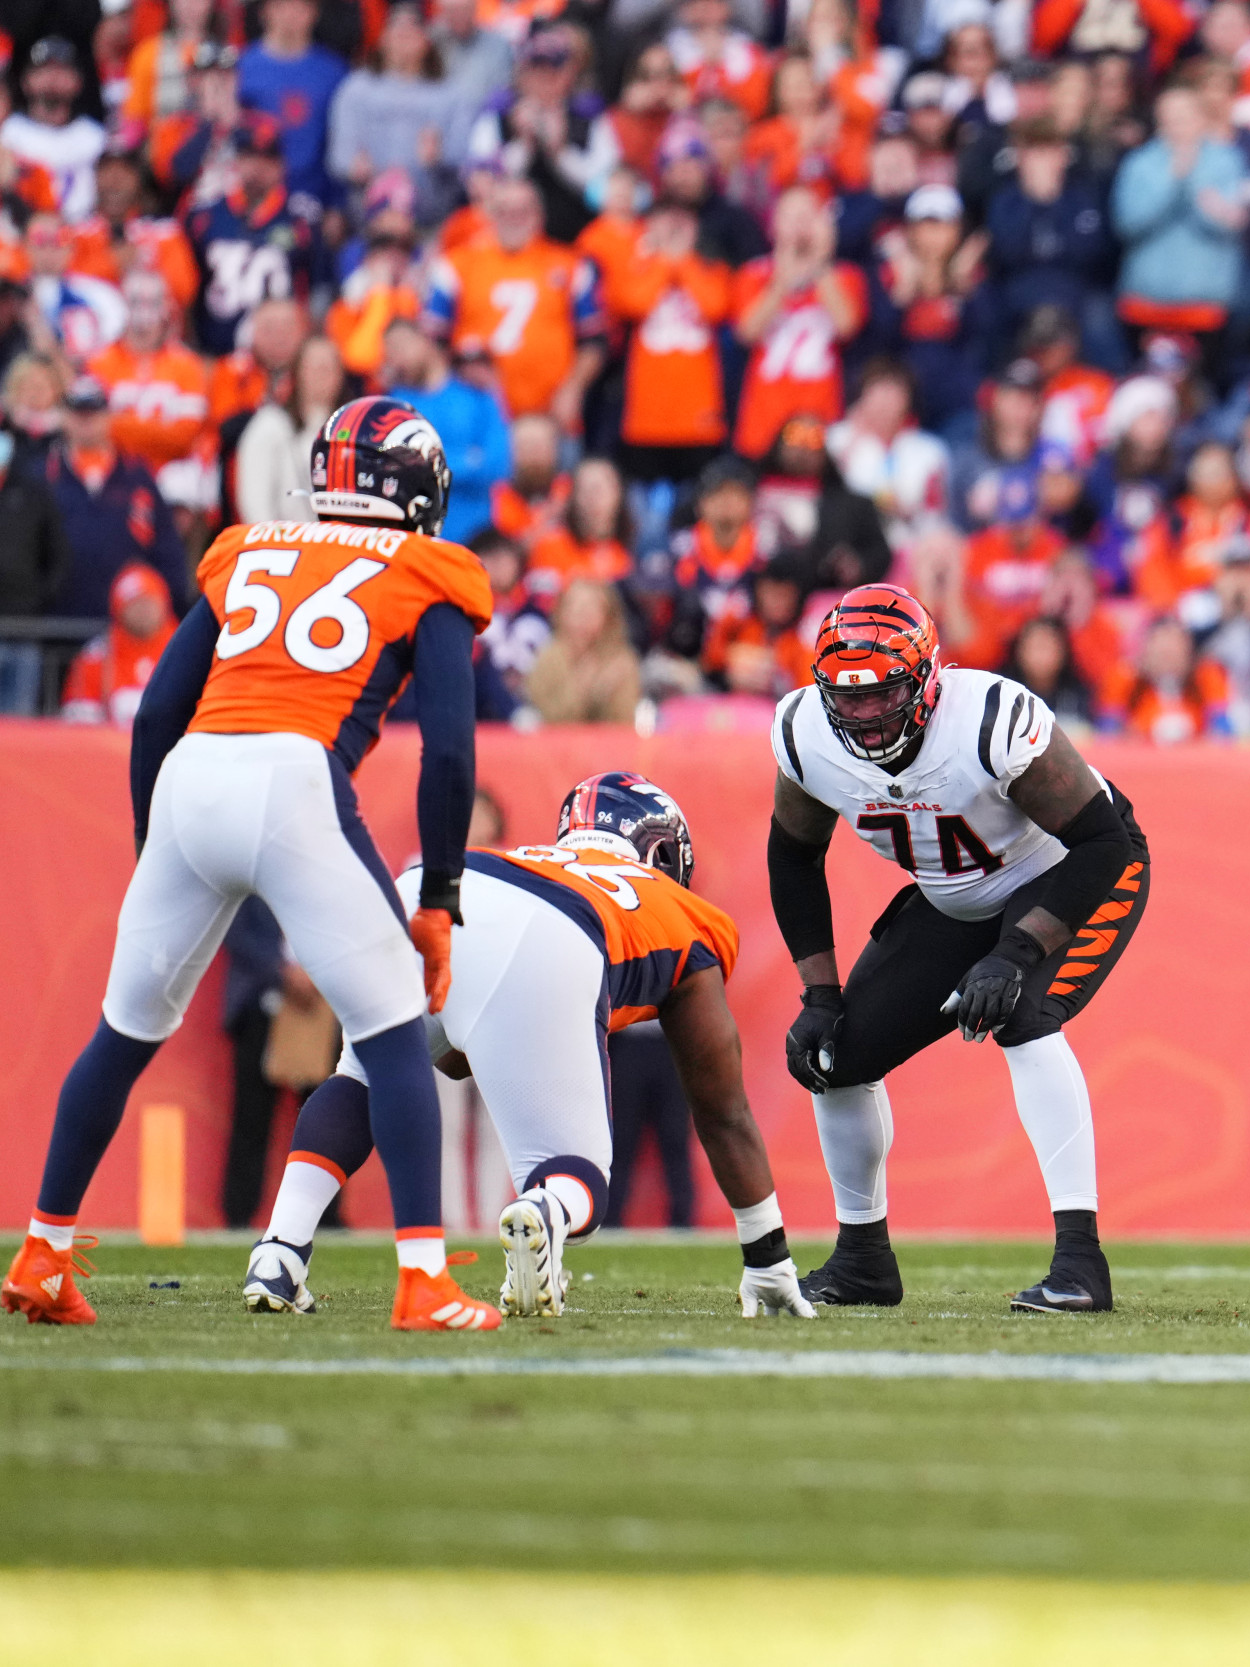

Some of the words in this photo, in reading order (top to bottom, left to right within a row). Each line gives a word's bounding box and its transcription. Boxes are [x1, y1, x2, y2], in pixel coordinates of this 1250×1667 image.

[489, 278, 538, 356] 7
[357, 471, 375, 488] 56
[244, 520, 408, 558] BROWNING
[215, 548, 389, 674] 56
[597, 811, 613, 824] 96
[856, 812, 1005, 880] 74
